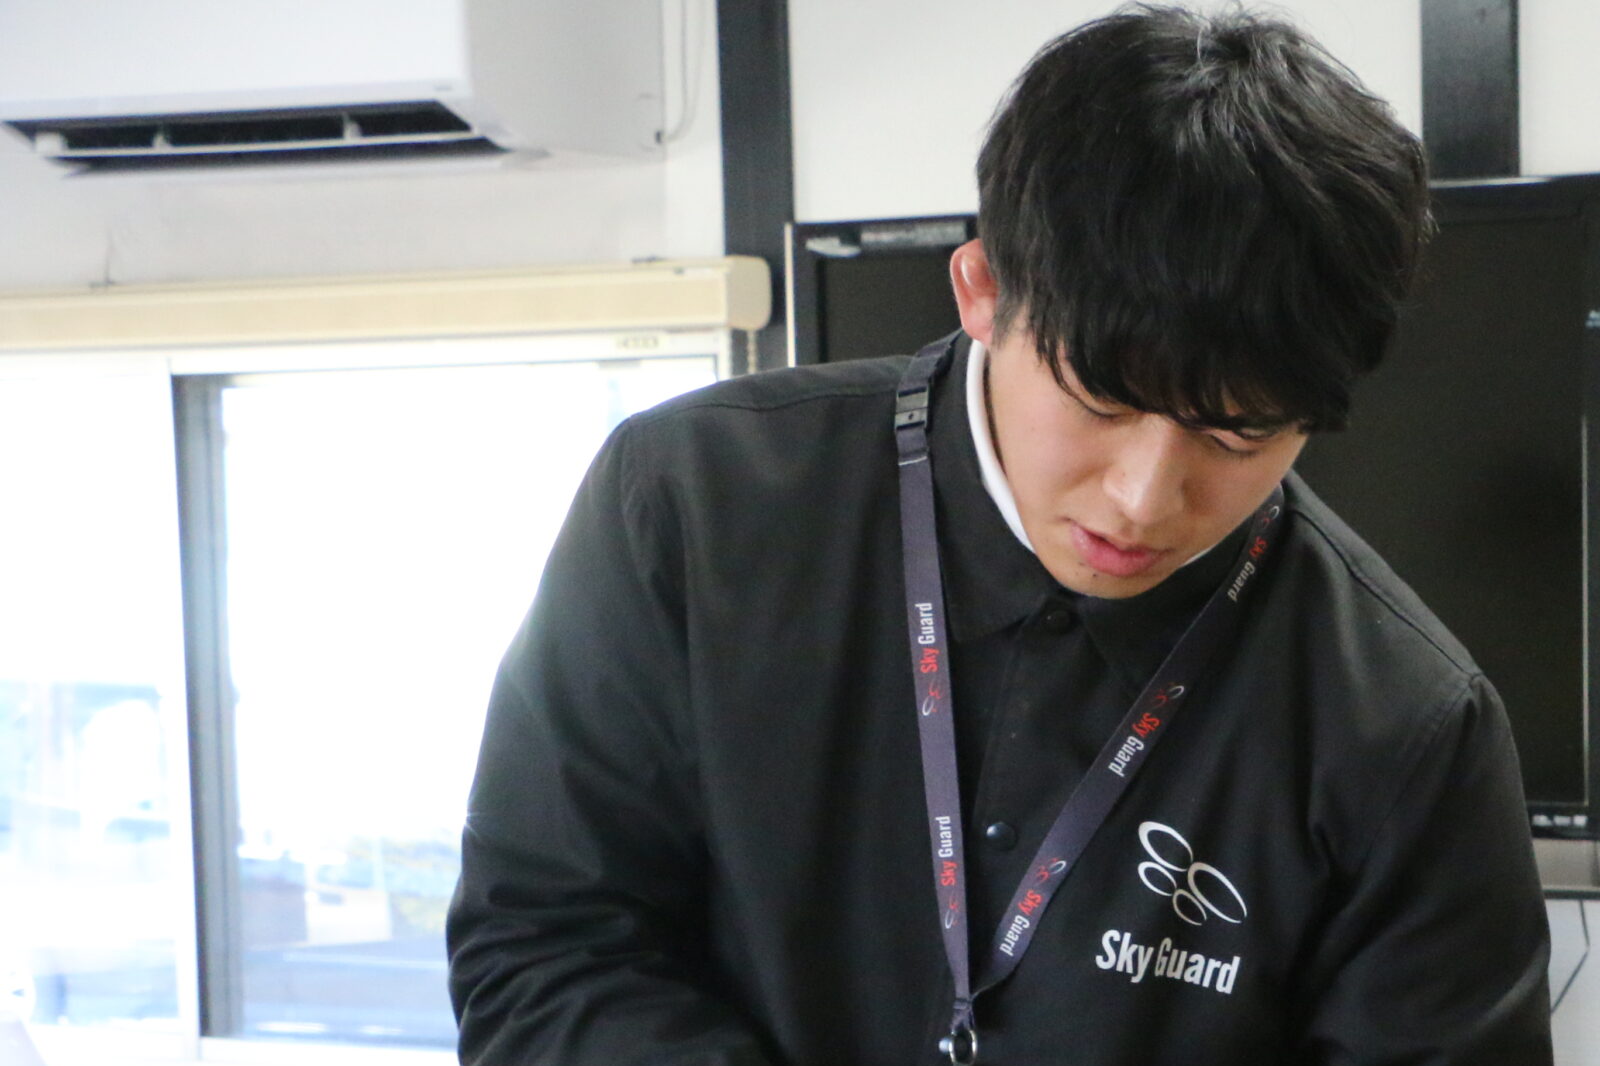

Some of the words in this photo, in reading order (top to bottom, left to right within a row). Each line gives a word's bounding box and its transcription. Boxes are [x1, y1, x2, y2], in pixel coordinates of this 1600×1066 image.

[1249, 536, 1267, 558] Sky
[1228, 561, 1256, 602] Guard
[915, 602, 935, 645] Guard
[920, 647, 939, 673] Sky
[1132, 713, 1160, 738] Sky
[1108, 736, 1145, 777] Guard
[935, 815, 953, 857] Guard
[940, 861, 958, 886] Sky
[1018, 889, 1043, 915] Sky
[999, 914, 1030, 957] Guard
[1095, 929, 1154, 984] Sky
[1154, 937, 1241, 995] Guard
